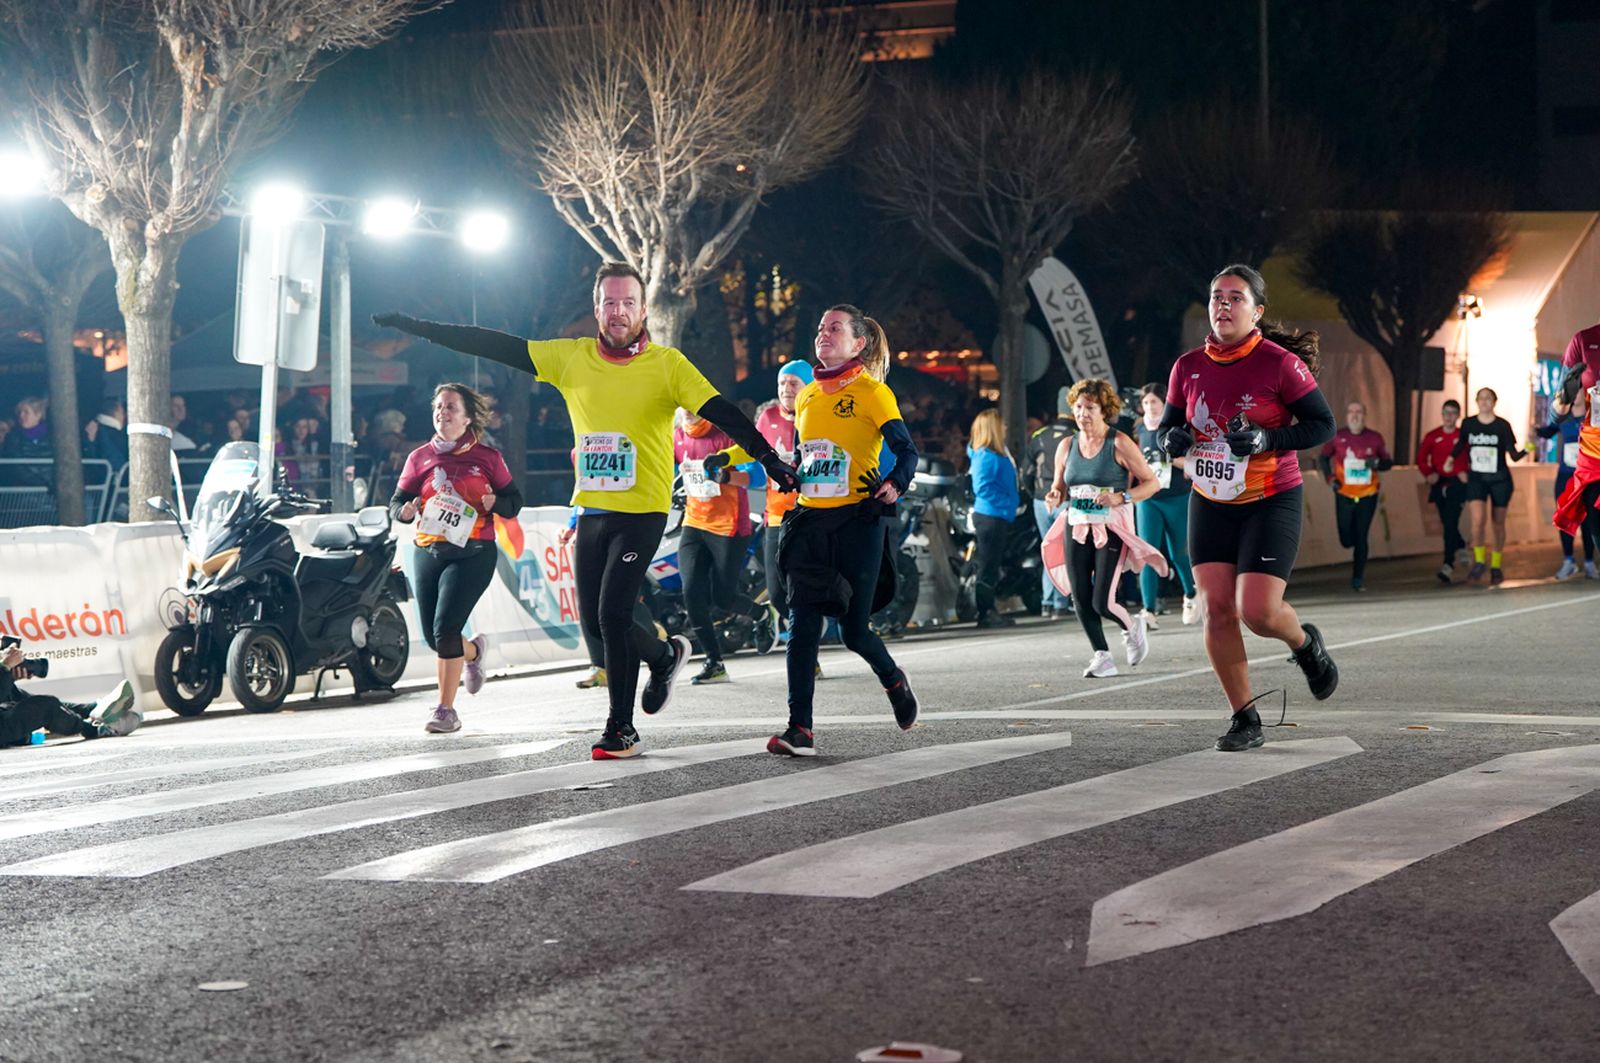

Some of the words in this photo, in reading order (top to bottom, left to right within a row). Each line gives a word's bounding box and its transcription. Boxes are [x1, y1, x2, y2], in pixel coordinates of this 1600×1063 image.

[1062, 282, 1110, 380] PEMASA
[585, 453, 626, 470] 12241
[1196, 459, 1235, 481] 6695
[438, 509, 461, 527] 743
[44, 646, 98, 660] maestras
